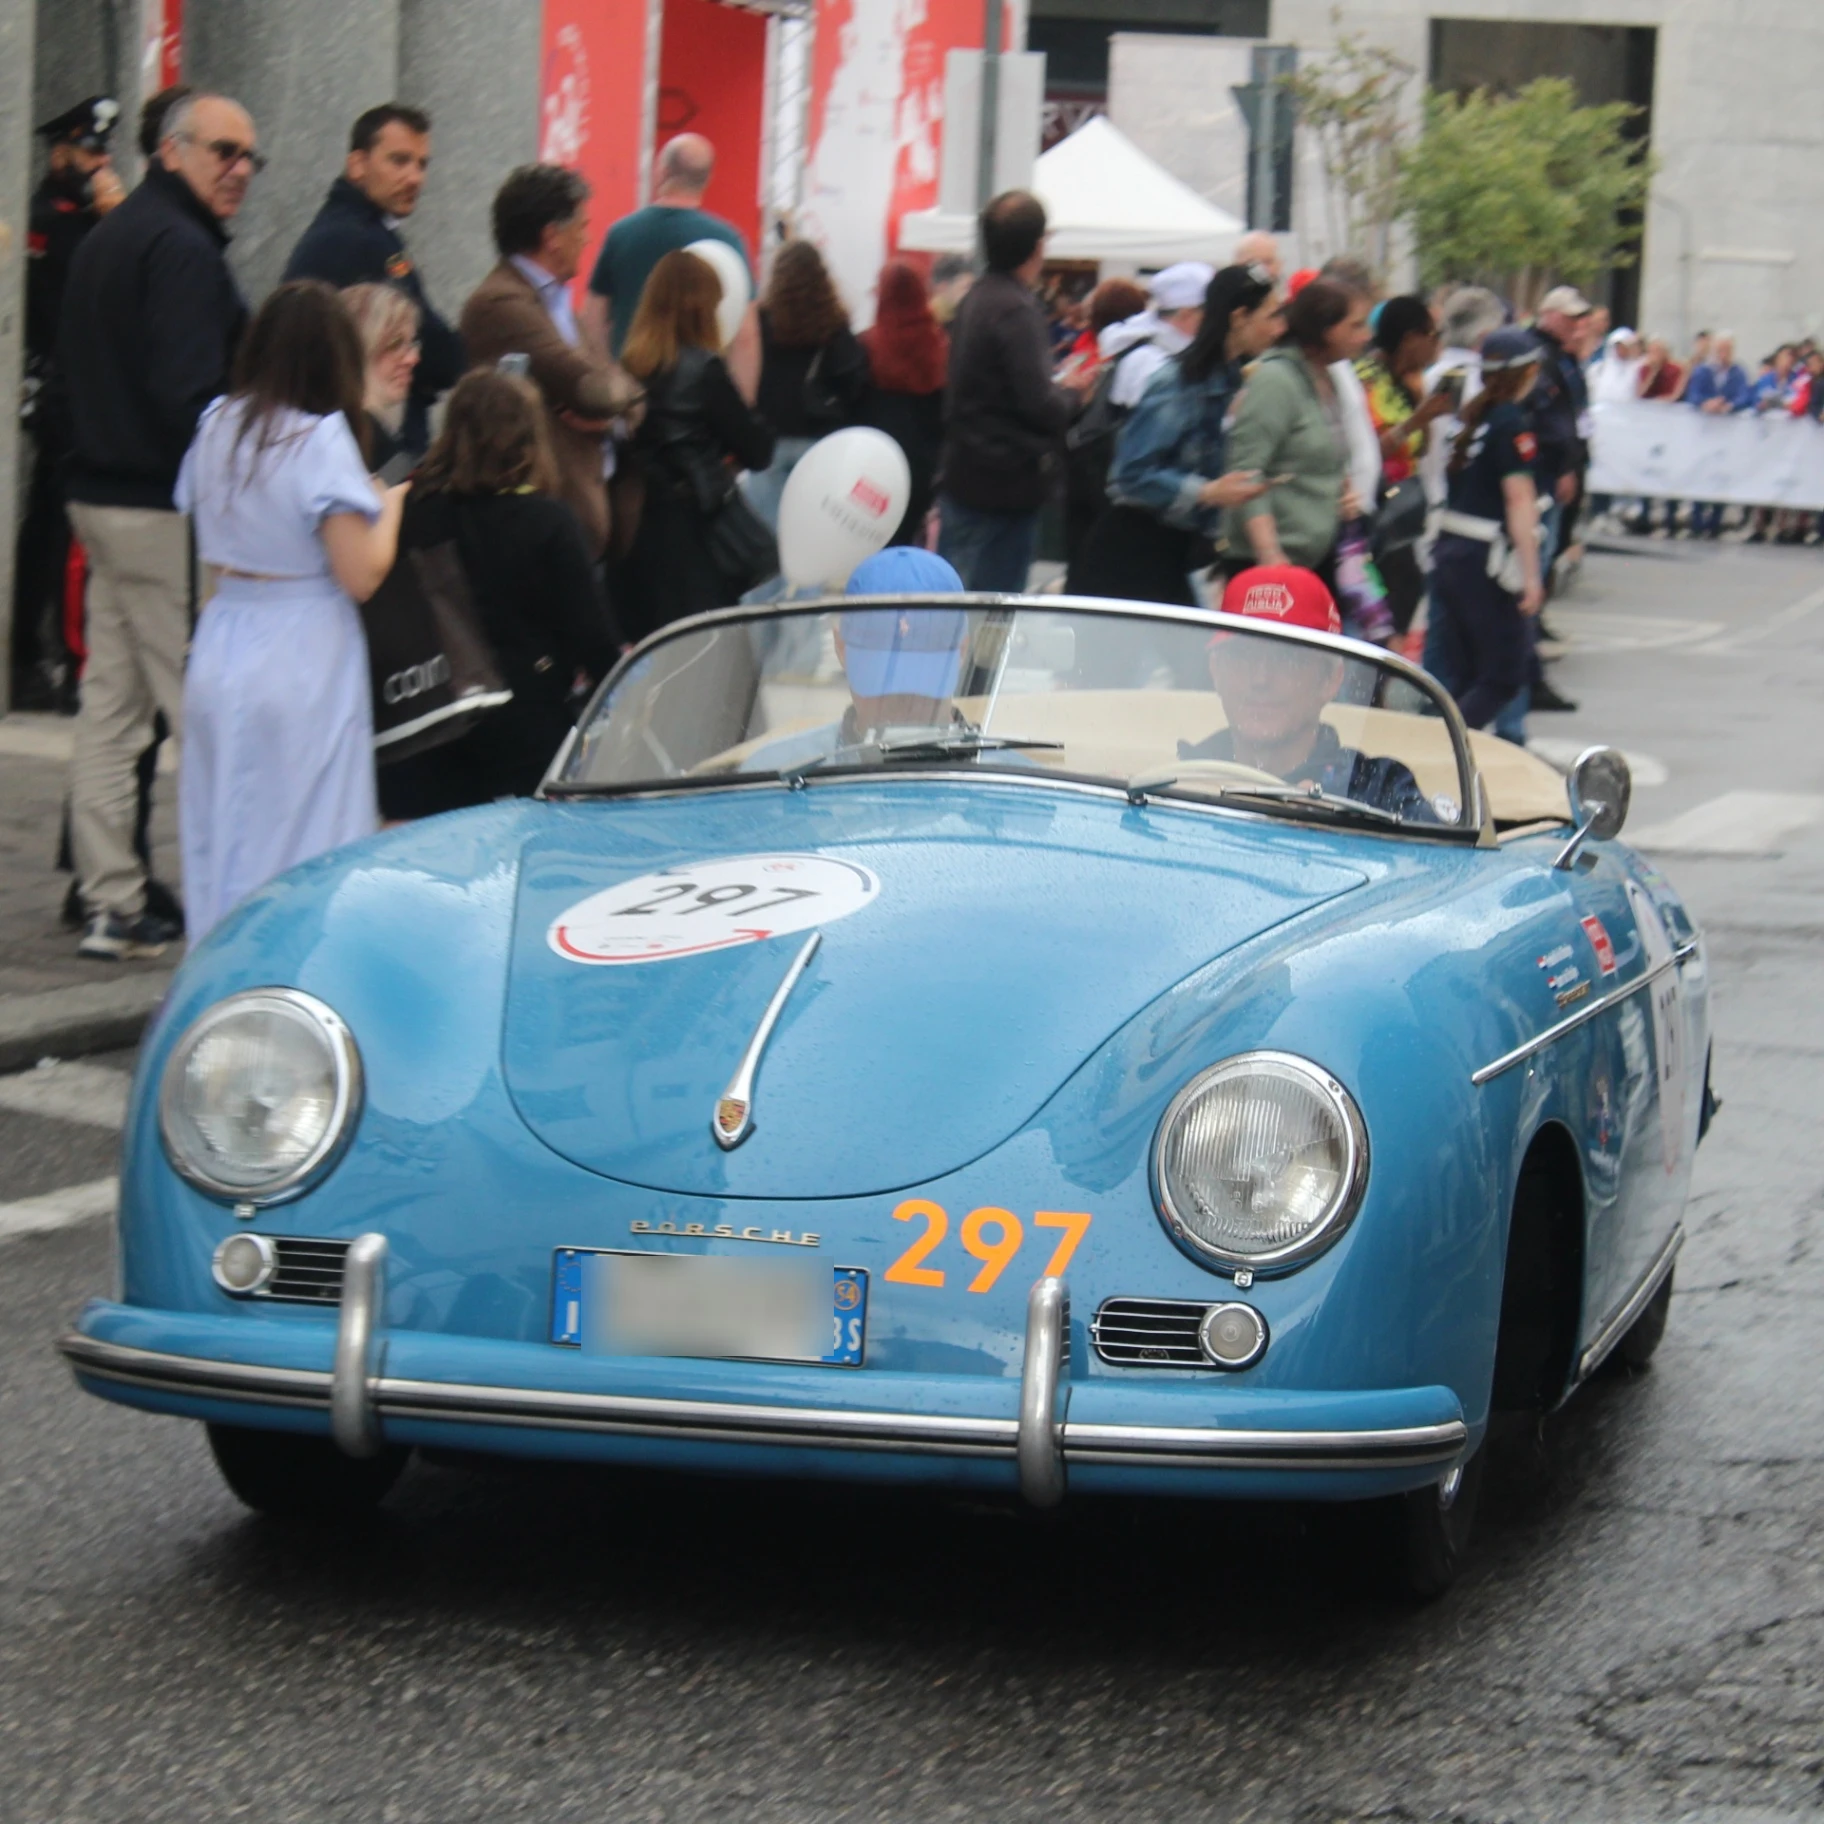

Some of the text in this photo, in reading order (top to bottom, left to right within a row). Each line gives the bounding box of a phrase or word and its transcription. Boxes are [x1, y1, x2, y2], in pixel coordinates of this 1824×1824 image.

[609, 883, 822, 918] 297
[630, 1219, 821, 1247] PORSCHE
[884, 1198, 1092, 1294] 297
